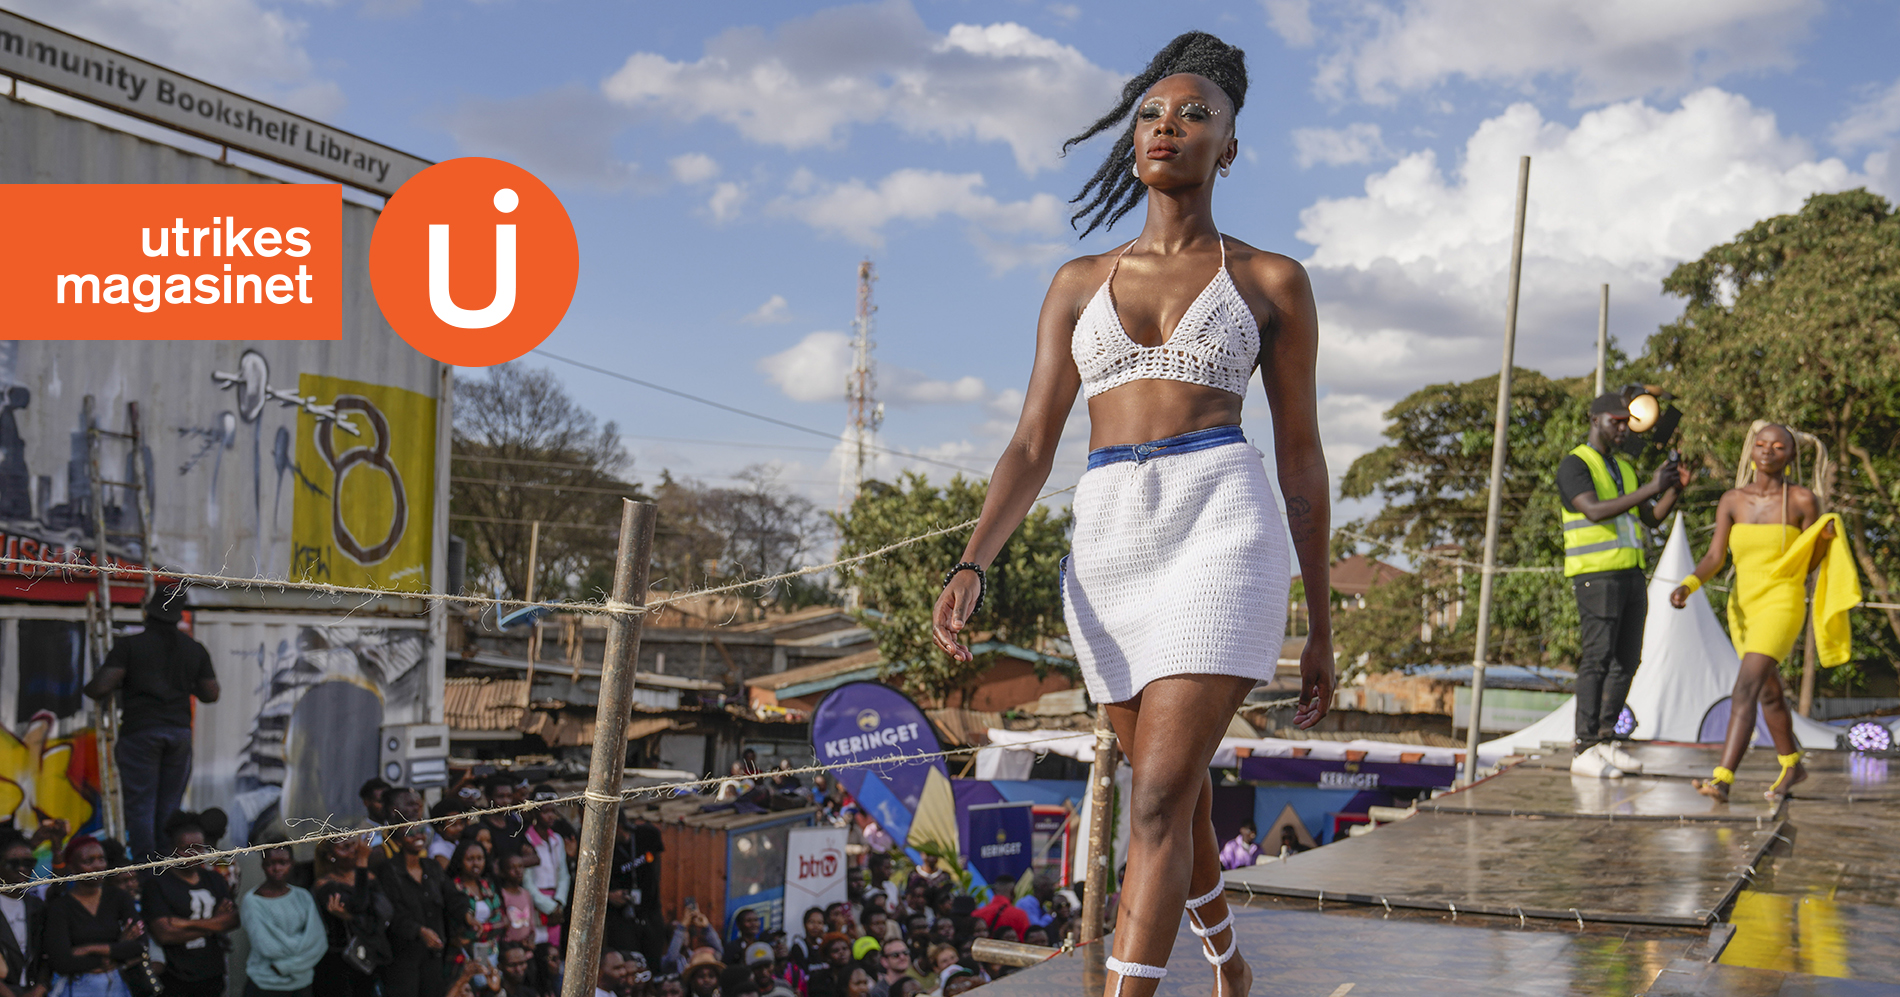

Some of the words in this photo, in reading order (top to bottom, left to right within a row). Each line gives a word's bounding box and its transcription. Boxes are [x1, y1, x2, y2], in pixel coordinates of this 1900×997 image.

[157, 78, 300, 146] Bookshelf
[305, 129, 390, 183] Library
[824, 722, 918, 758] KERINGET
